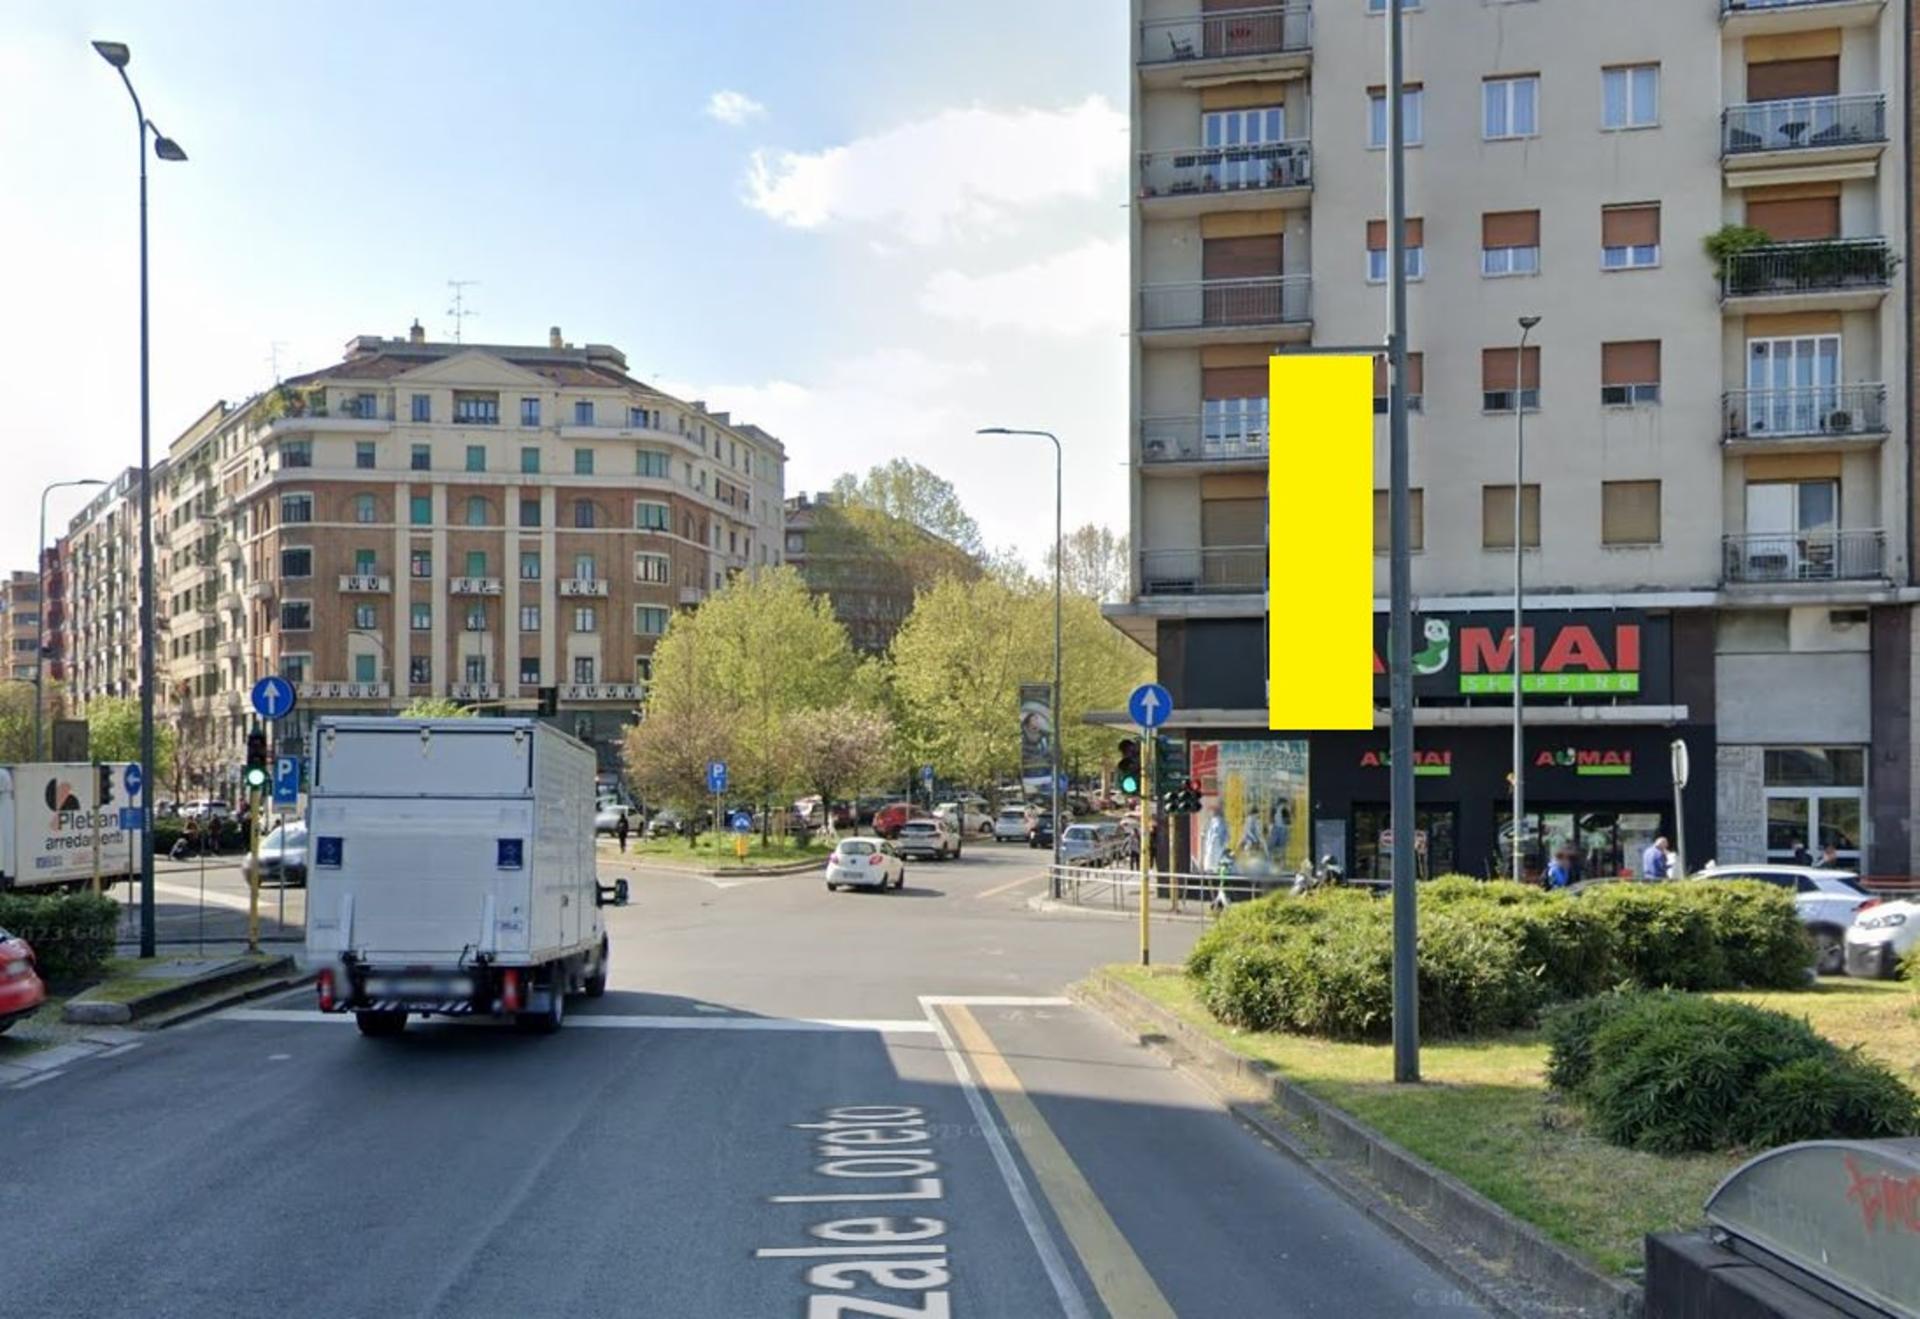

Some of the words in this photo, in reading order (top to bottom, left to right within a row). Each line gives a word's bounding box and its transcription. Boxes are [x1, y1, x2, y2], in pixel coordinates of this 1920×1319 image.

[1535, 747, 1631, 766] AUMAI
[278, 759, 292, 782] P
[713, 763, 724, 777] P
[45, 831, 124, 850] arredaenti
[768, 1105, 943, 1202] Loreto
